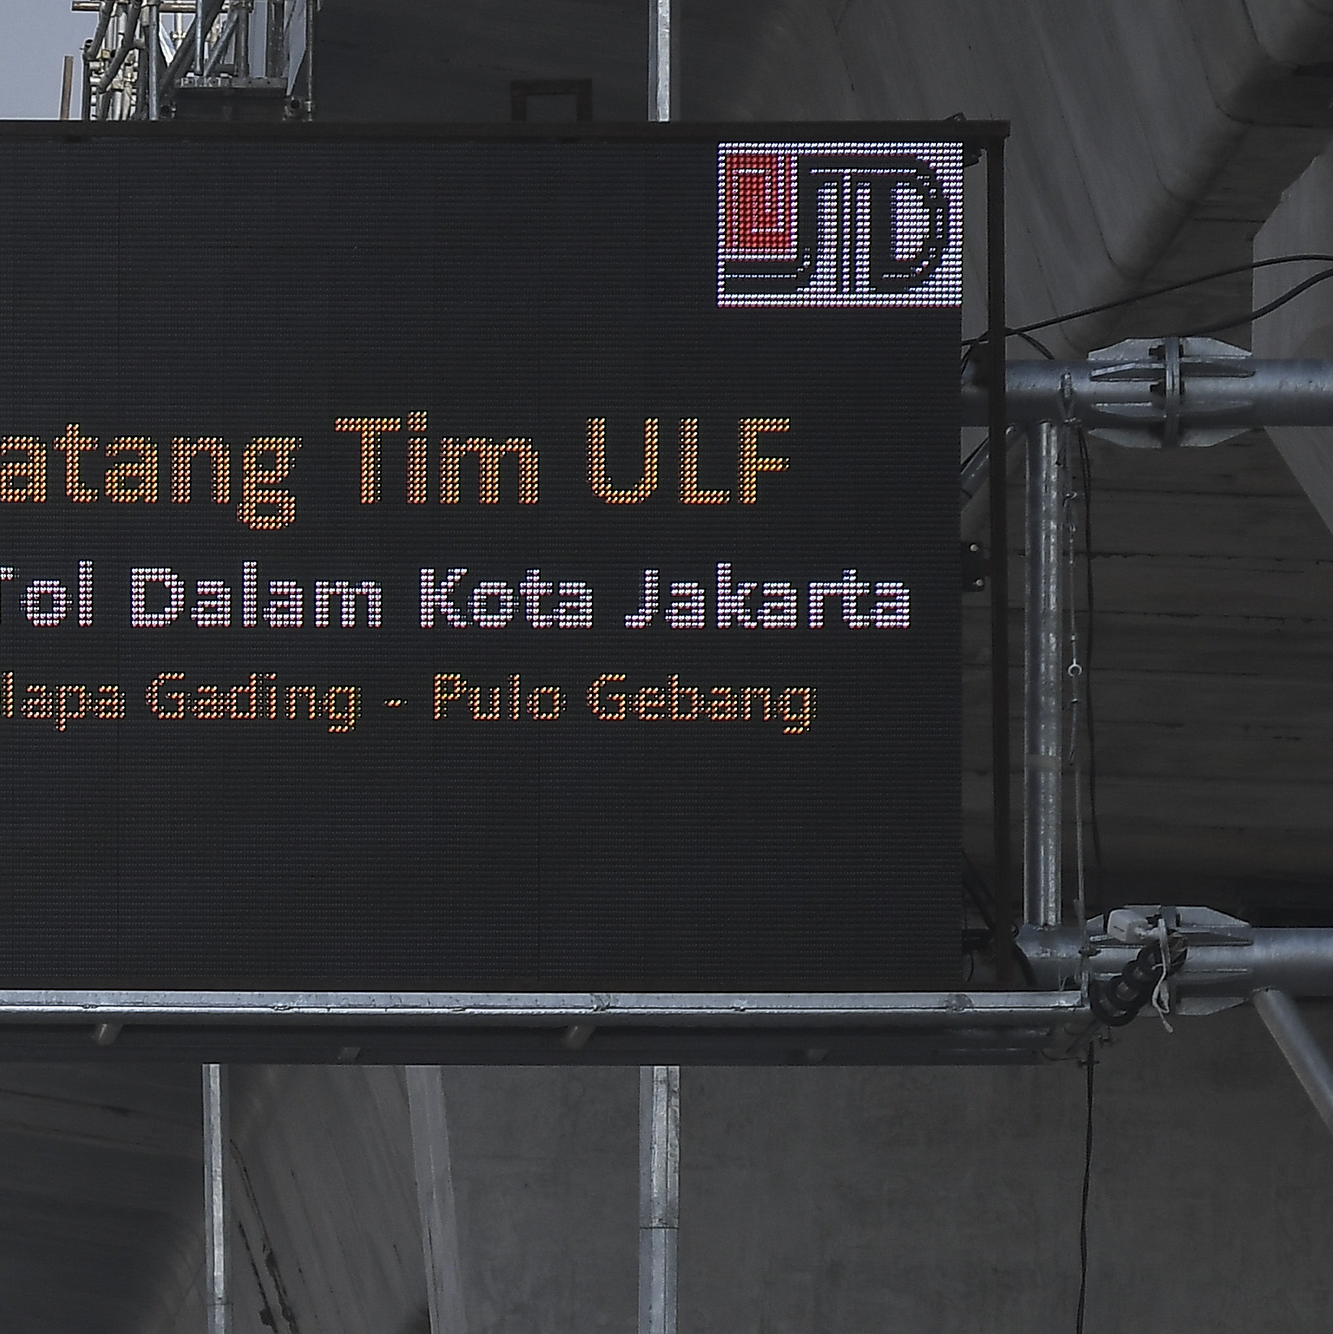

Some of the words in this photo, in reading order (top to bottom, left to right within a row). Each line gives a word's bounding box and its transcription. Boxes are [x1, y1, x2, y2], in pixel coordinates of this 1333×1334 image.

[334, 411, 539, 504] Tim
[586, 417, 790, 504] ULF
[130, 561, 382, 628] Dalam
[419, 567, 593, 629] Kota
[623, 562, 910, 629] Jakarta
[144, 672, 361, 733] Gading
[433, 673, 566, 720] Pulo
[585, 673, 817, 733] Gebang
